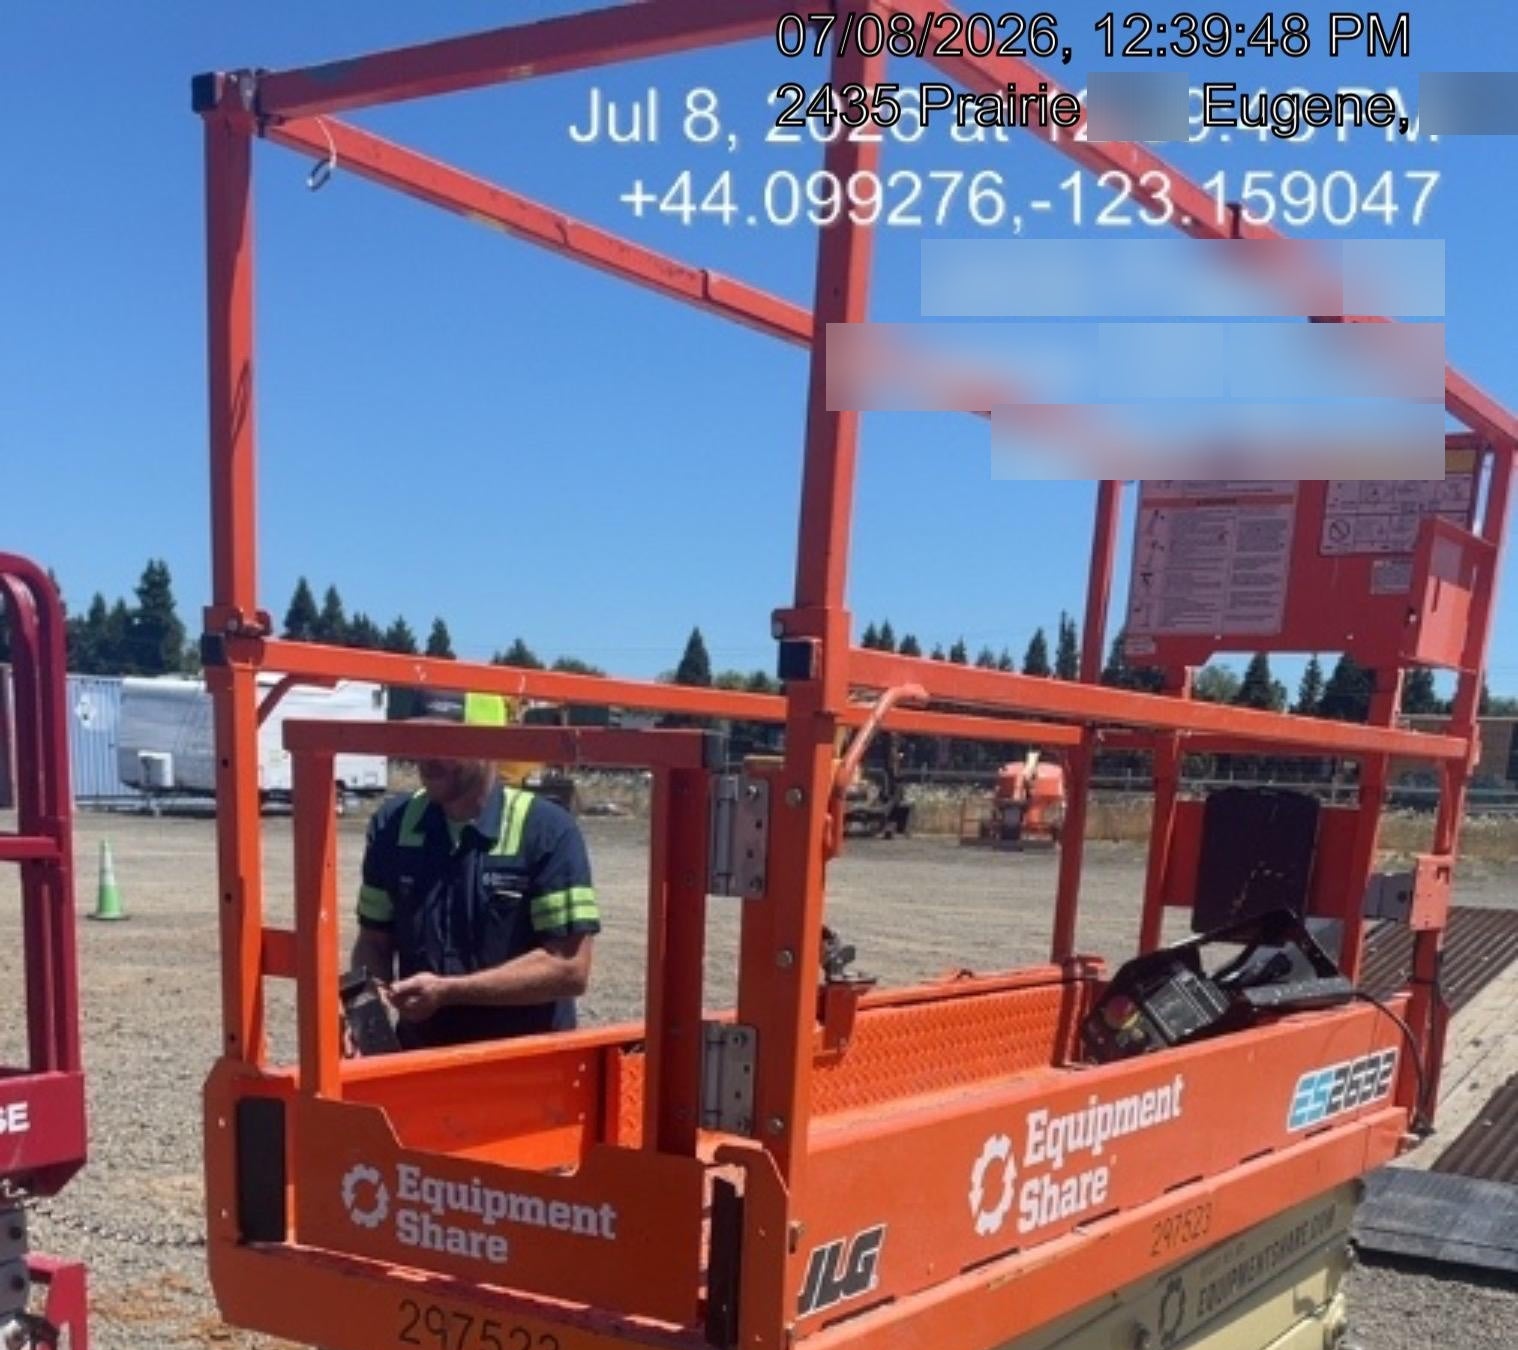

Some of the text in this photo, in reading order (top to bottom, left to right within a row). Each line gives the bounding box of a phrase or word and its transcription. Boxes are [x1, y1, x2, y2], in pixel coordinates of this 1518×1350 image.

[1023, 1075, 1184, 1167] Equipment
[1287, 1047, 1398, 1134] ES2632
[397, 1163, 616, 1239] Equipment
[1017, 1163, 1108, 1233] Share
[1150, 1201, 1213, 1258] 297523
[399, 1212, 508, 1263] Share
[797, 1224, 886, 1320] JLG
